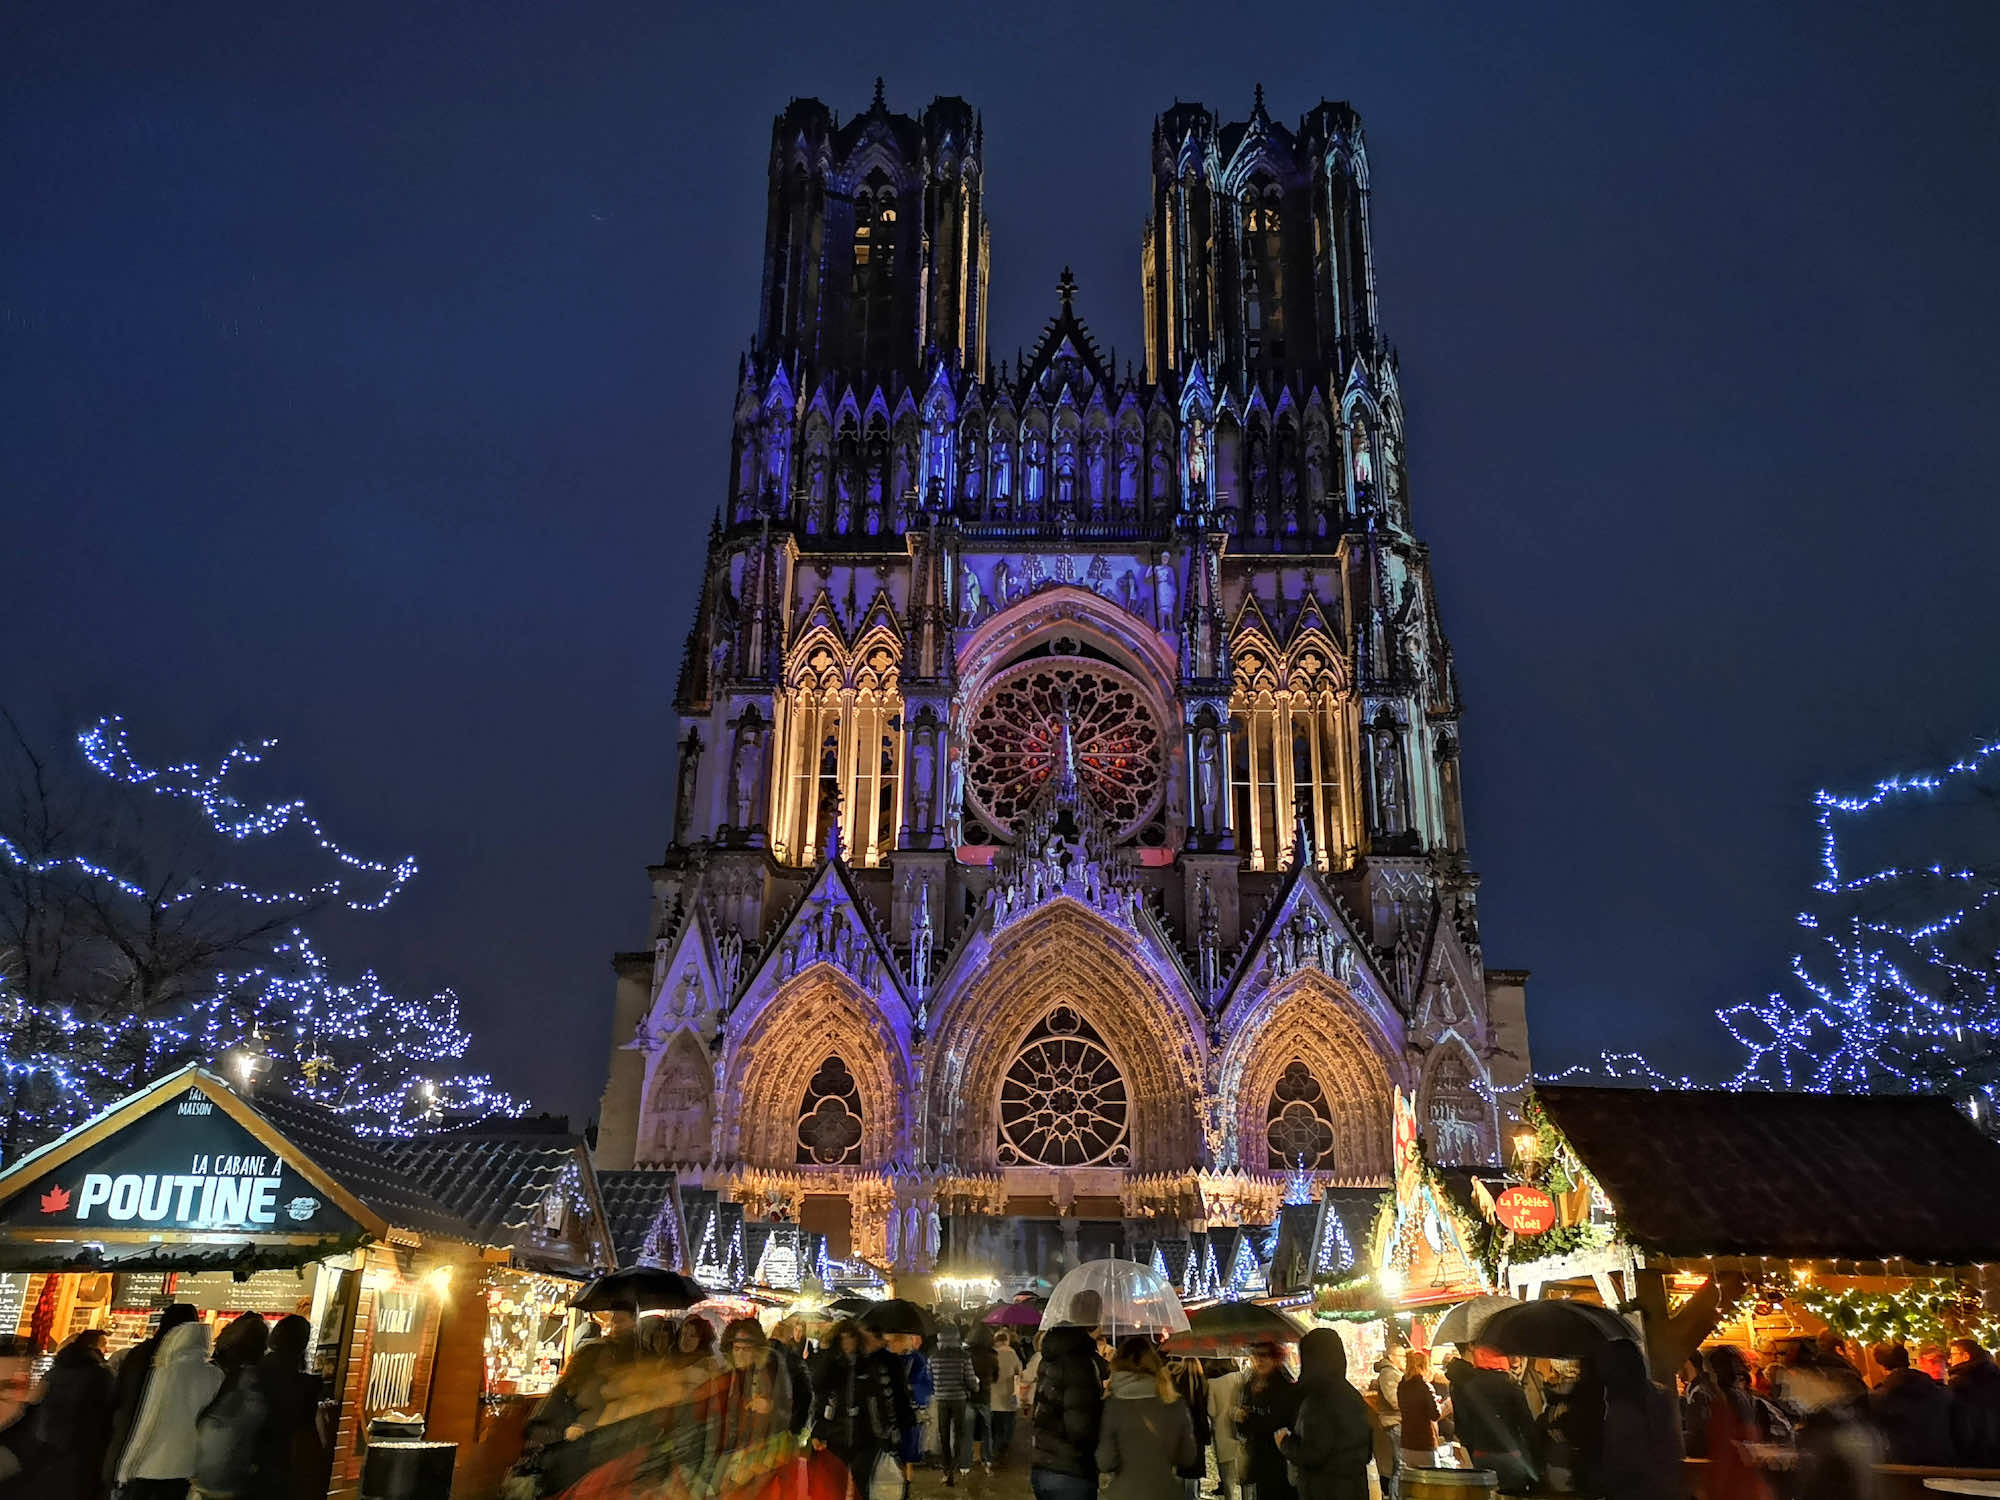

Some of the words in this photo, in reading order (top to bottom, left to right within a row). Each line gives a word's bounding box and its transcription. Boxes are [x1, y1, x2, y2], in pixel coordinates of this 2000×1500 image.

[177, 1102, 213, 1116] MAISON
[192, 1154, 209, 1174] LA
[214, 1154, 268, 1176] CABANE
[76, 1173, 282, 1224] POUTINE
[365, 1352, 417, 1412] POUTINE
